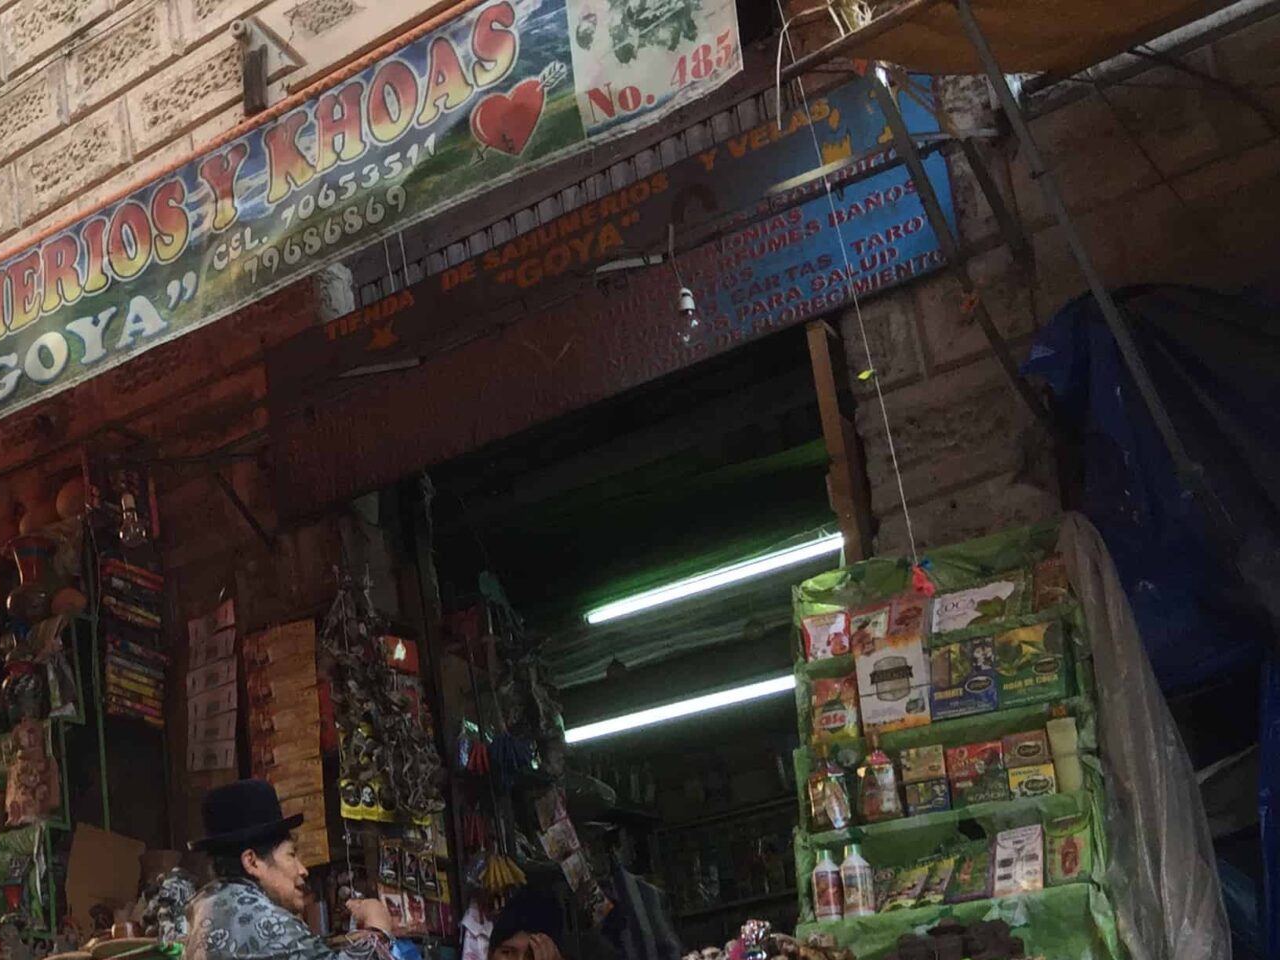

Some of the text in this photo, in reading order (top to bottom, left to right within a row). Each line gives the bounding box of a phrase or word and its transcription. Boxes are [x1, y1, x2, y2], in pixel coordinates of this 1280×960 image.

[198, 140, 250, 233] Y
[264, 1, 517, 205] KHOAS
[586, 30, 734, 123] No. 485
[281, 133, 437, 229] 70653511
[441, 264, 477, 293] DE
[697, 150, 716, 172] Y
[244, 185, 407, 283] 79686869
[811, 247, 899, 292] SALUD
[850, 214, 926, 255] TARO
